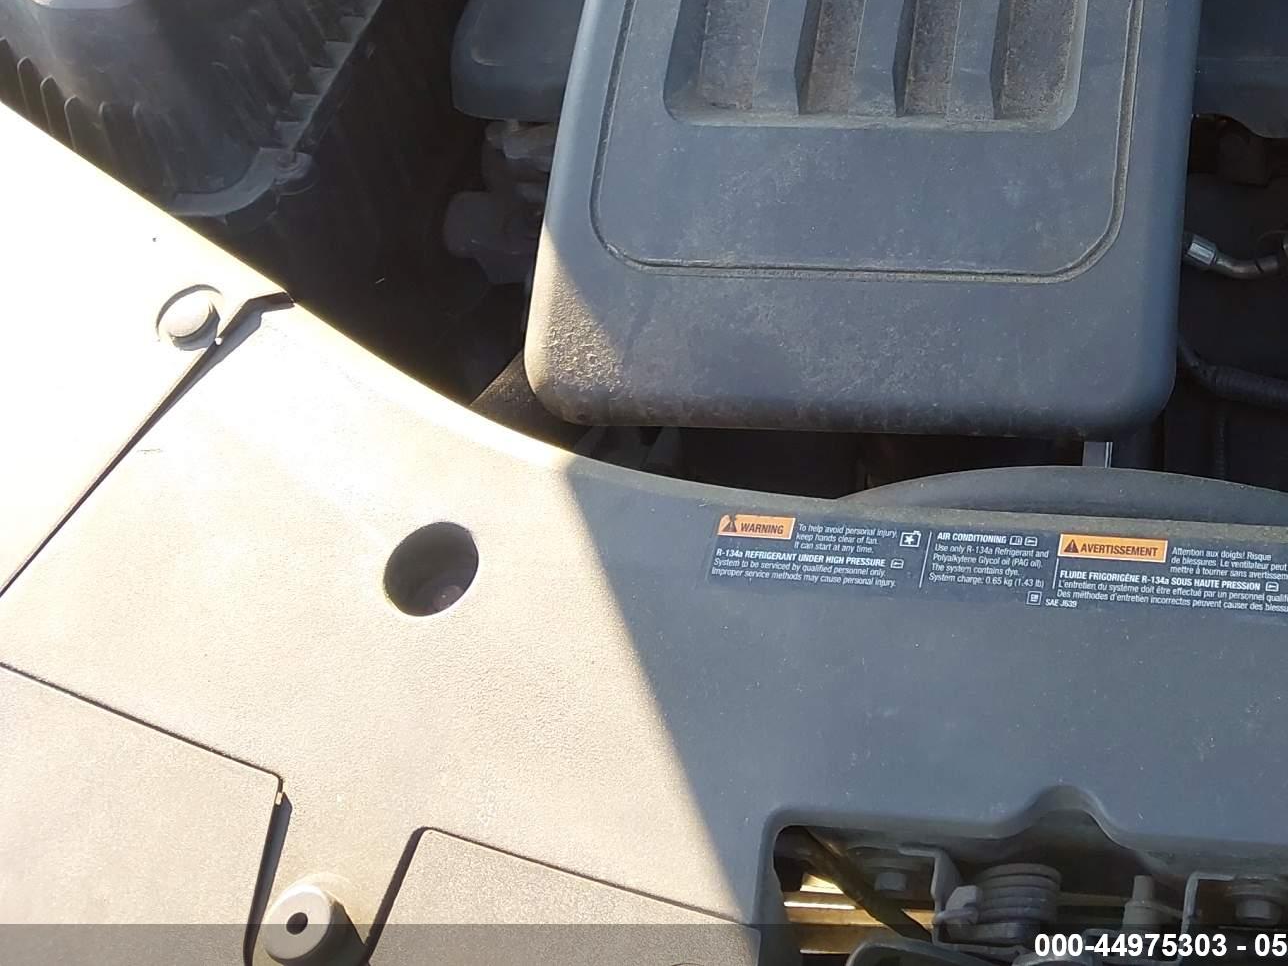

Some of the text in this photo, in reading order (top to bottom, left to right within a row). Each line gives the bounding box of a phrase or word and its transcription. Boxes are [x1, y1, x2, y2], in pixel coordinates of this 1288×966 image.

[740, 522, 784, 535] WARNING
[799, 524, 807, 532] To
[808, 524, 824, 534] help
[824, 526, 845, 534] avoid
[845, 527, 876, 537] personal
[796, 532, 813, 541] keep
[814, 533, 836, 541] hands
[838, 534, 855, 543] clear
[856, 536, 865, 544] of
[937, 532, 1007, 544] AIR CONDITIONING
[800, 542, 814, 550] can
[815, 542, 831, 551] start
[832, 544, 840, 552] at
[841, 545, 855, 553] any
[856, 545, 874, 554] time.
[935, 543, 1050, 558] Use only R-134a Refrigerant and
[1080, 543, 1159, 557] AVERTISSEMENT
[1172, 547, 1272, 562] Attention aux doigts! Risque
[716, 548, 886, 567] R-134a REFRIGERANT UNDER HIGH PRESSURE
[933, 553, 977, 565] Polyalkylene
[978, 555, 1000, 566] Glycol
[1001, 556, 1010, 565] oil
[1012, 557, 1029, 567] (PAG
[1171, 556, 1180, 564] de
[1220, 559, 1229, 567] Le
[1231, 561, 1269, 570] ventilateur
[1270, 563, 1287, 572] peut
[713, 558, 740, 567] System
[741, 560, 749, 568] to
[750, 560, 760, 568] be
[760, 561, 791, 571] serviced
[791, 563, 800, 572] by
[802, 564, 832, 574] qualified
[833, 566, 869, 576] personnel
[932, 562, 945, 572] The
[946, 564, 972, 574] system
[973, 565, 1004, 575] contains
[1170, 566, 1194, 574] mettre
[1202, 567, 1229, 576] tourner
[1230, 570, 1247, 578] sans
[711, 567, 743, 578] Improper
[744, 570, 770, 579] service
[770, 571, 802, 581] methods
[803, 574, 818, 583] may
[820, 575, 842, 583] cause
[842, 576, 874, 586] personal
[928, 572, 955, 582] System
[957, 574, 984, 586] charge:
[1003, 577, 1013, 588] kg
[1059, 570, 1087, 580] FLUIDE
[1141, 575, 1170, 585] R-134a
[1171, 577, 1193, 587] SOUS
[1194, 578, 1220, 588] HAUTE
[1221, 580, 1261, 591] PRESSION
[1098, 581, 1108, 590] du
[1140, 585, 1155, 594] doit
[1203, 590, 1217, 599] par
[1228, 592, 1265, 602] personnel
[1045, 598, 1059, 607] SAE
[1057, 589, 1071, 598] Des
[1150, 595, 1191, 606] incorrectes
[1192, 598, 1222, 608] peuvent
[1223, 600, 1248, 610] causer
[1249, 602, 1263, 611] des
